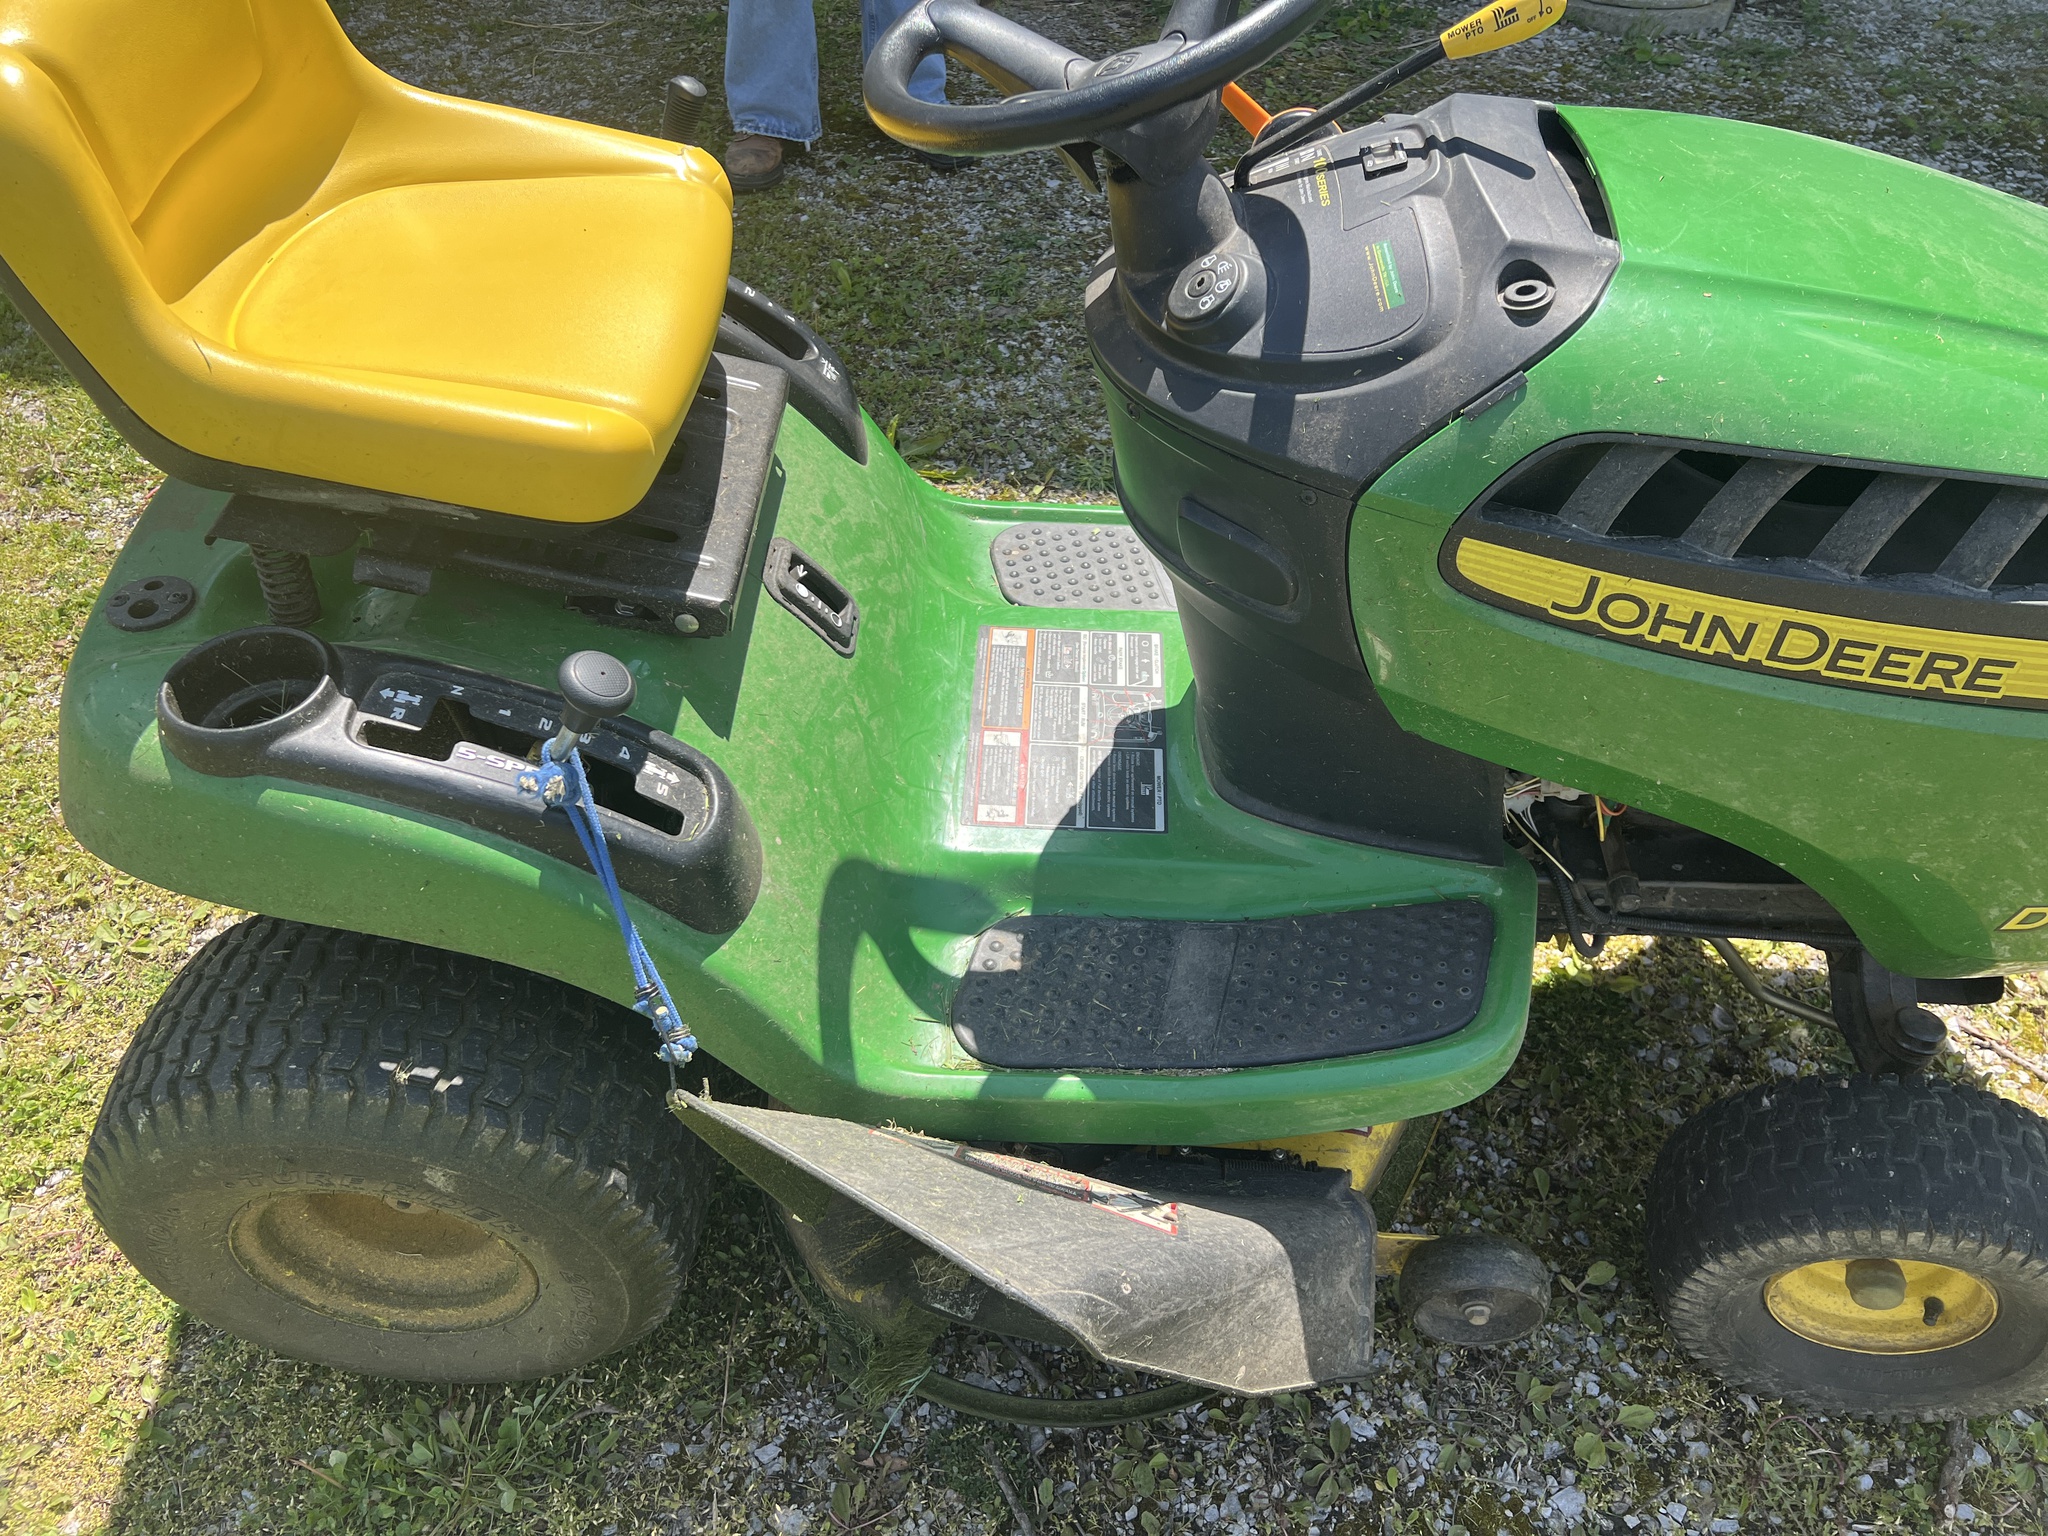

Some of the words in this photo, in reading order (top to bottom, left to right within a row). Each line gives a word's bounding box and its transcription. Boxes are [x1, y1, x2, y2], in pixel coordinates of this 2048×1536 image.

[1526, 15, 1537, 23] OFF
[1447, 18, 1482, 40] MOWER
[1465, 26, 1484, 40] PTO
[1316, 173, 1330, 206] SERIES
[1364, 245, 1384, 313] www.JohnDeere.com
[1549, 574, 1761, 659] JOHN
[1762, 619, 2020, 695] DEERE
[450, 684, 465, 696] N
[390, 706, 406, 720] R
[498, 708, 512, 718] 1
[538, 717, 553, 731] 2
[619, 746, 631, 760] 4
[656, 781, 669, 797] 5
[240, 1170, 366, 1190] TURF
[382, 1181, 524, 1234] RIDER
